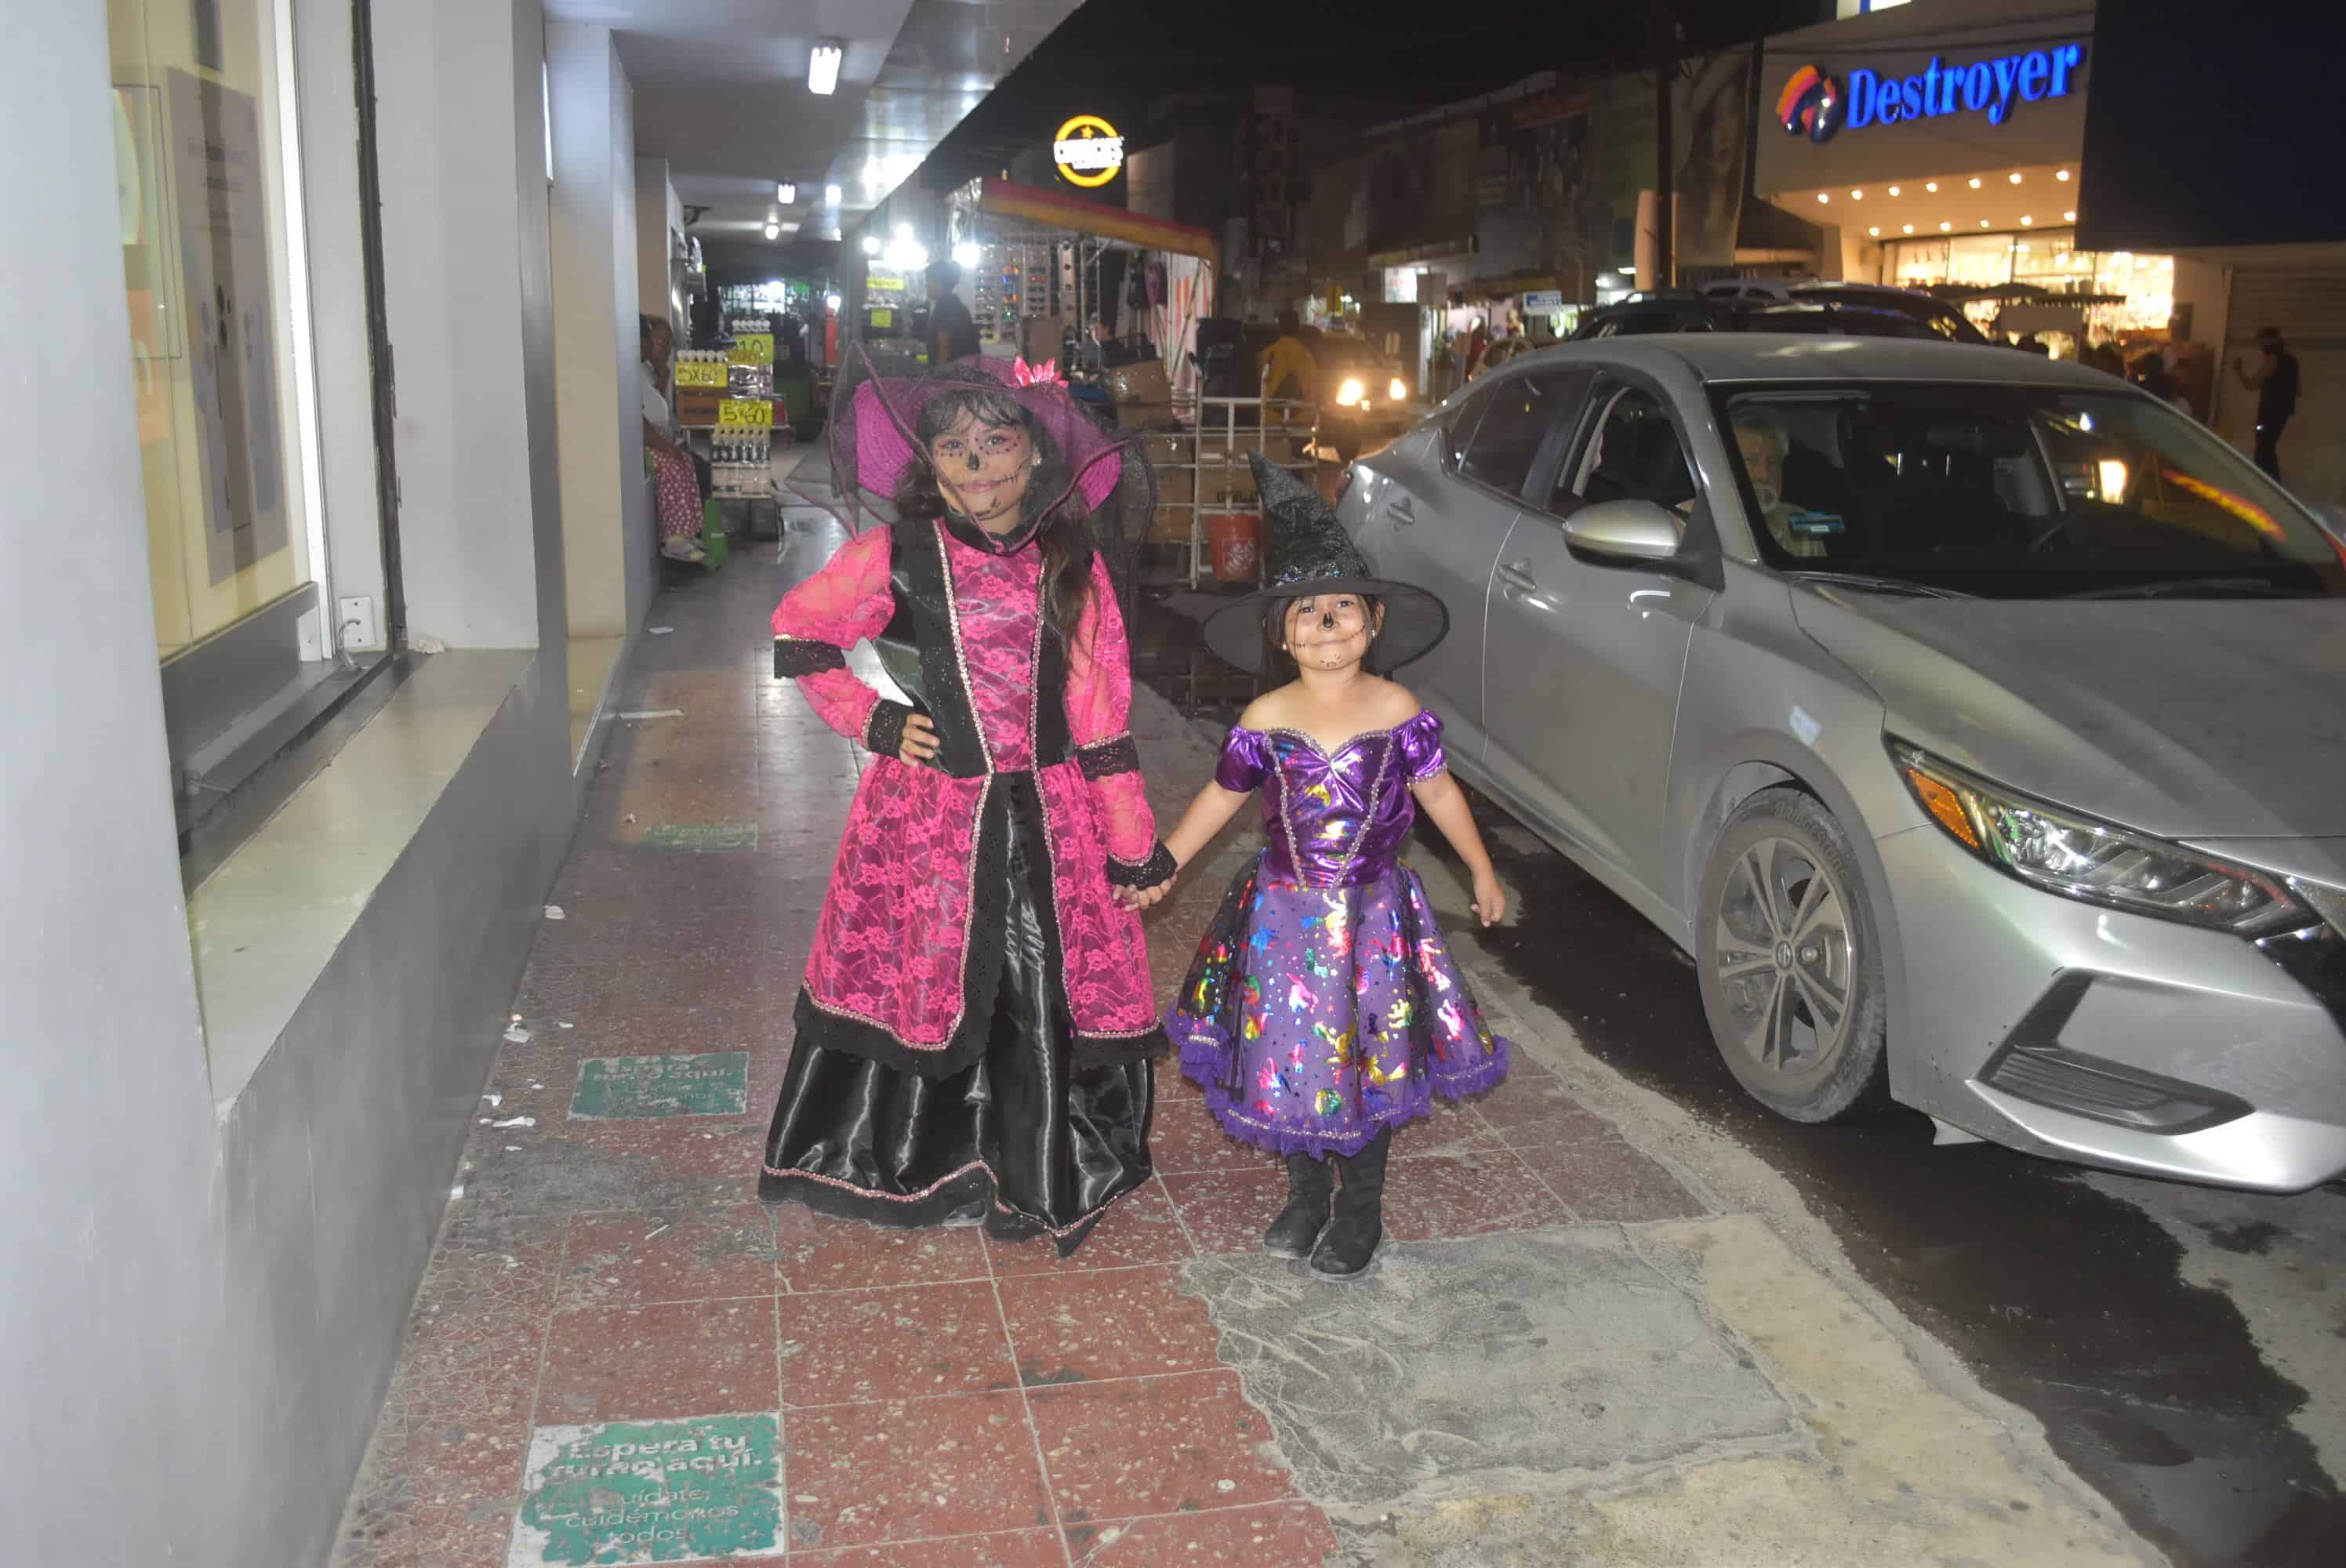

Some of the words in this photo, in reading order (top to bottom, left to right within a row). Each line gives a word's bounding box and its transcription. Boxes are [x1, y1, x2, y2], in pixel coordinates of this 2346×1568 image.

[1847, 42, 2083, 129] Destroyer
[568, 1438, 699, 1461] Espera
[565, 1504, 741, 1528] cuidémonos
